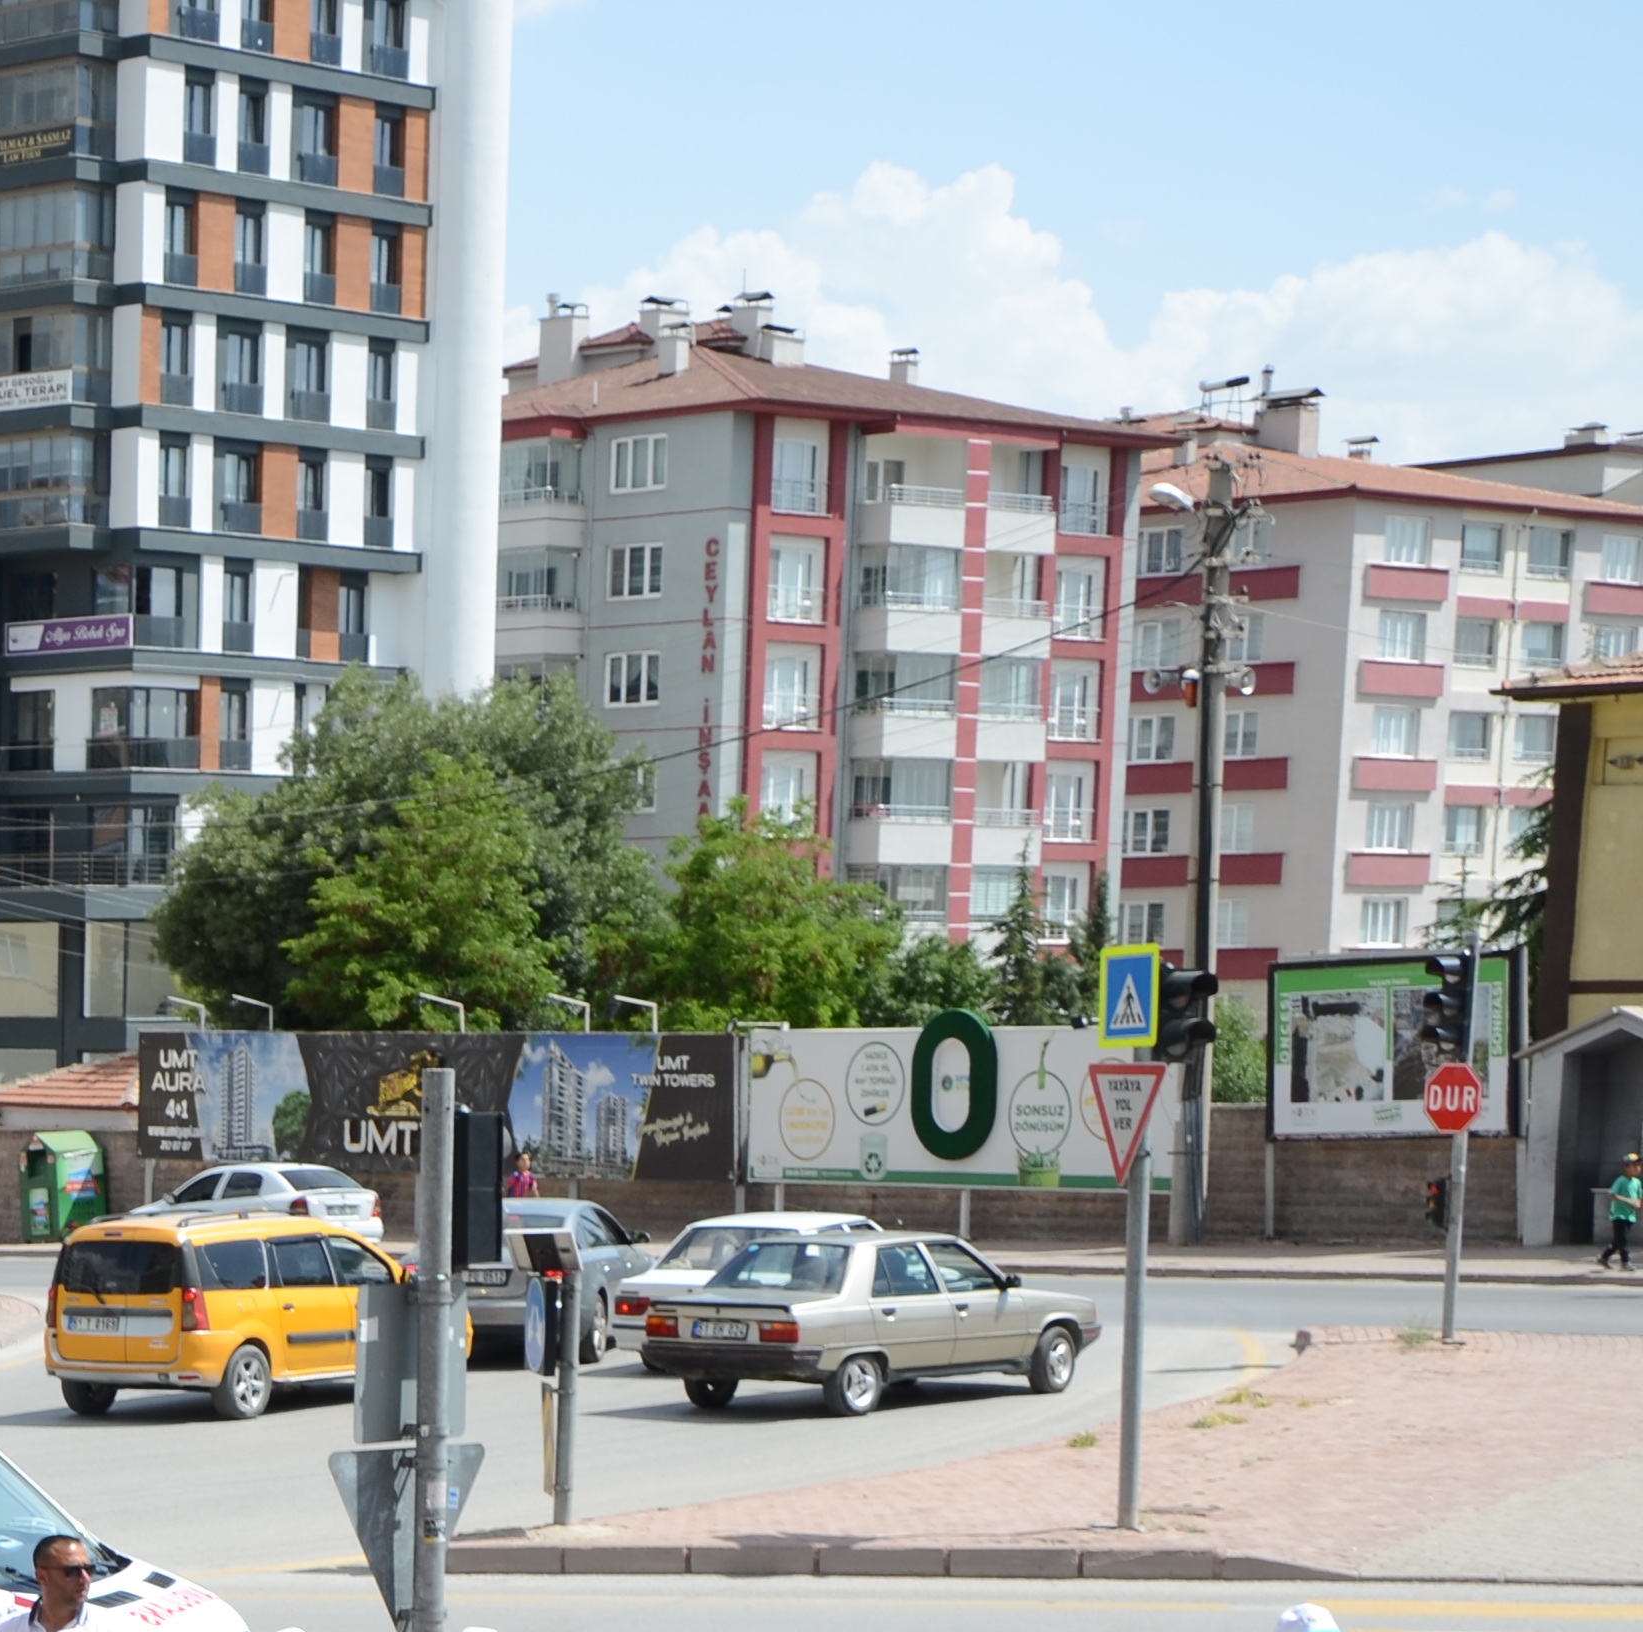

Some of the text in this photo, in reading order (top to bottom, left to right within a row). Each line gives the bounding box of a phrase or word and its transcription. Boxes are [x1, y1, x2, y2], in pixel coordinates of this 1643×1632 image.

[25, 383, 68, 396] TERAPİ
[701, 538, 720, 674] CEYLAN
[698, 697, 713, 815] İNŞAA
[159, 1049, 198, 1069] UMT
[657, 1054, 691, 1071] UMT
[151, 1072, 207, 1092] AURA
[631, 1073, 716, 1088] TWIN TOWERS
[1114, 1098, 1133, 1112] YOL
[1429, 1085, 1476, 1112] DUR
[1016, 1104, 1064, 1117] SONSUZ
[1015, 1120, 1065, 1133] DÖNÜŞÜM
[1113, 1117, 1132, 1130] VER
